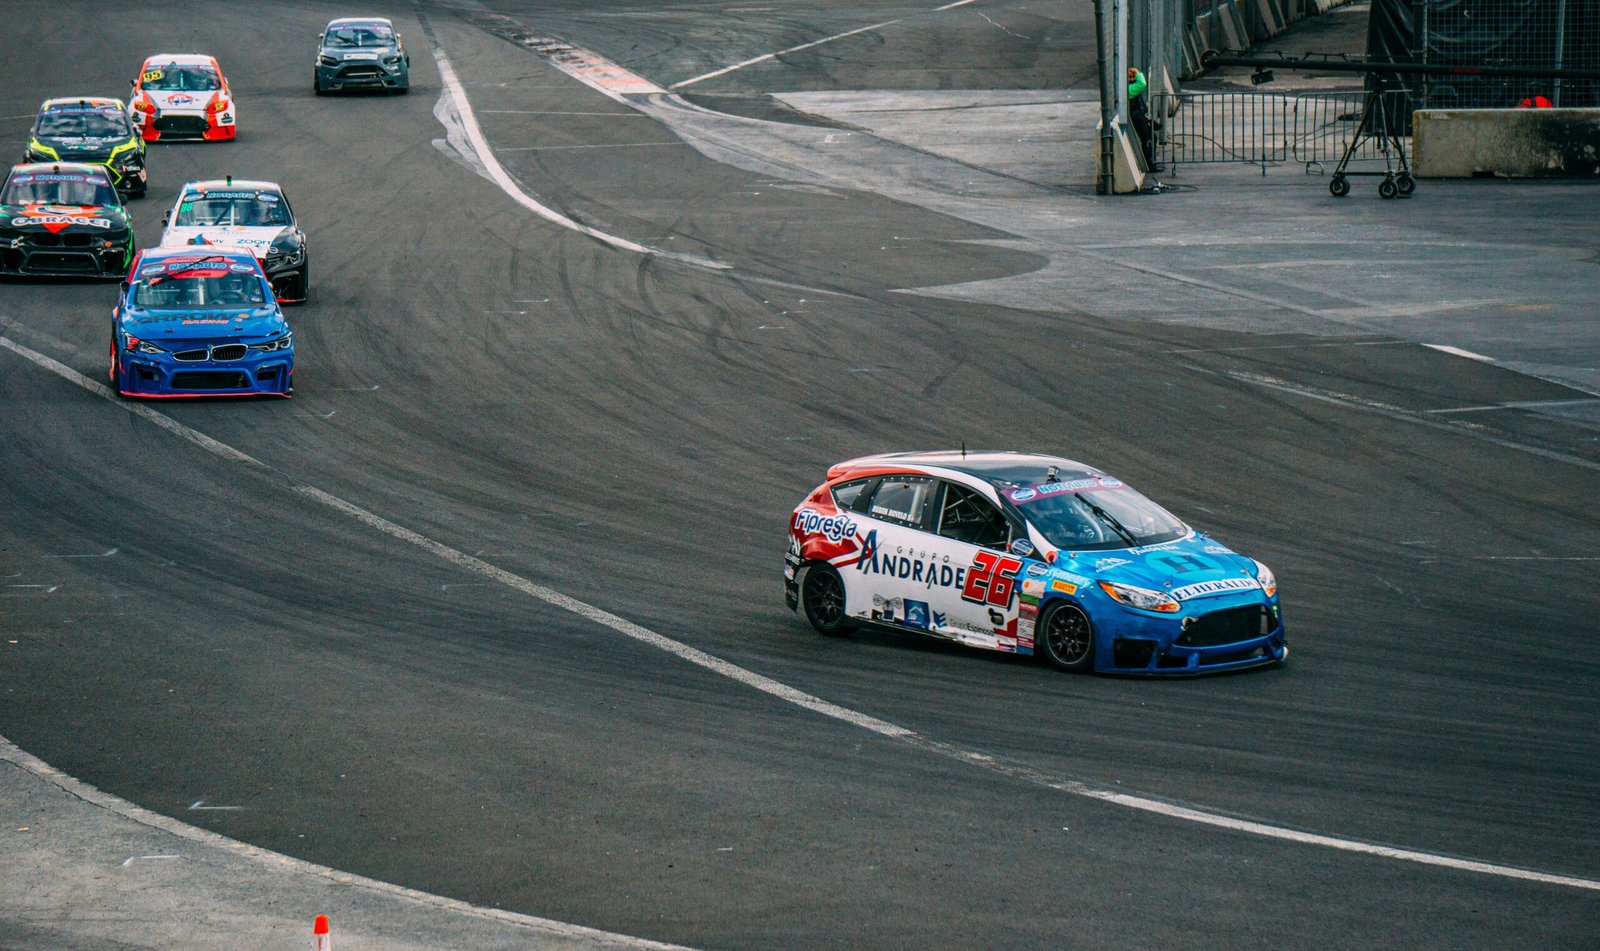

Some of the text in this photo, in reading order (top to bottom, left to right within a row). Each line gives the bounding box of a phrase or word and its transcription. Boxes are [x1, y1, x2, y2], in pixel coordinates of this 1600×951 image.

[143, 70, 162, 81] 95
[795, 510, 858, 539] Fipresta
[856, 529, 964, 589] ANDRADE
[897, 545, 950, 564] GRUPO
[962, 549, 1023, 611] 26
